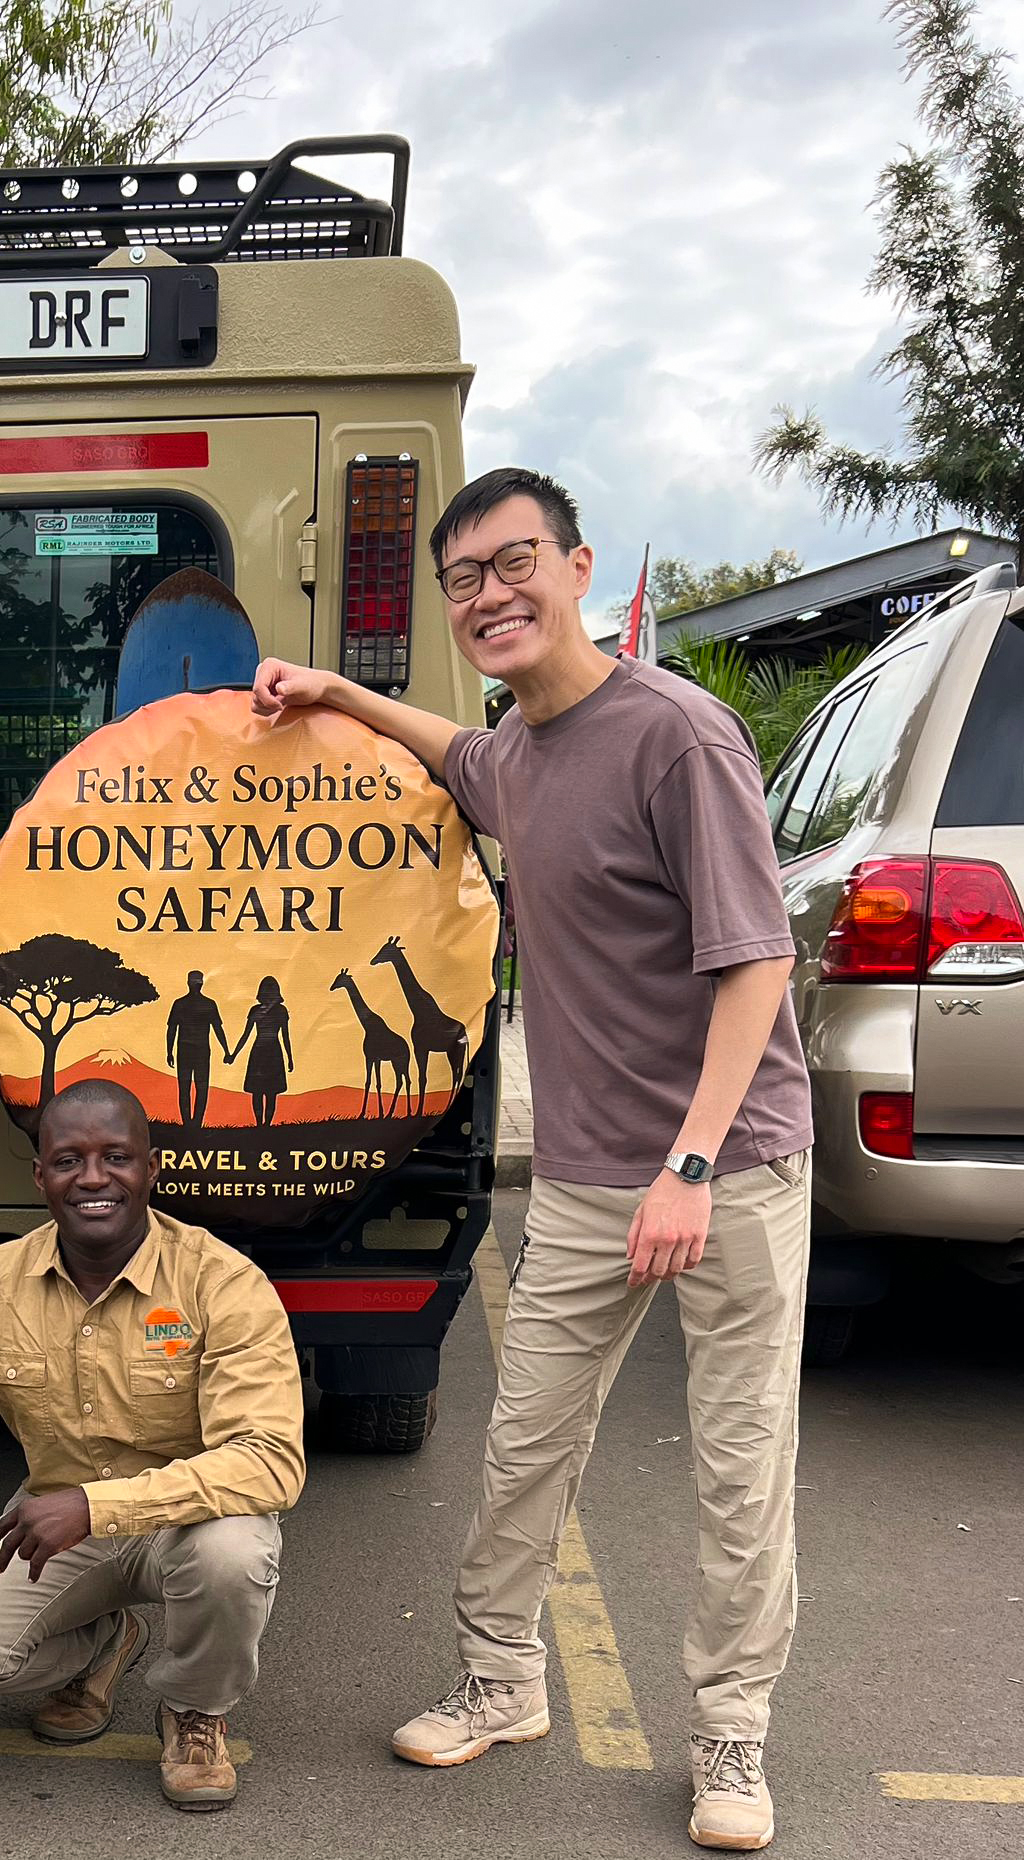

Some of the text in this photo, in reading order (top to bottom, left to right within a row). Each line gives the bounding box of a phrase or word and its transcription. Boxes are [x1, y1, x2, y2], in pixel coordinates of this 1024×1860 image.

[28, 289, 130, 349] DRF
[73, 447, 114, 461] SASO
[71, 514, 156, 523] FABRICATED BODY
[42, 542, 63, 550] RML
[74, 765, 174, 804] Felix
[183, 765, 219, 804] &
[25, 822, 445, 872] HONEYMOON
[116, 886, 345, 933] SAFARI
[934, 999, 985, 1016] VX
[160, 1149, 386, 1171] RAVEL & TOURS
[156, 1179, 356, 1197] LOVE MEETS THE WILD
[363, 1291, 402, 1303] SASO
[145, 1323, 190, 1337] LINDO
